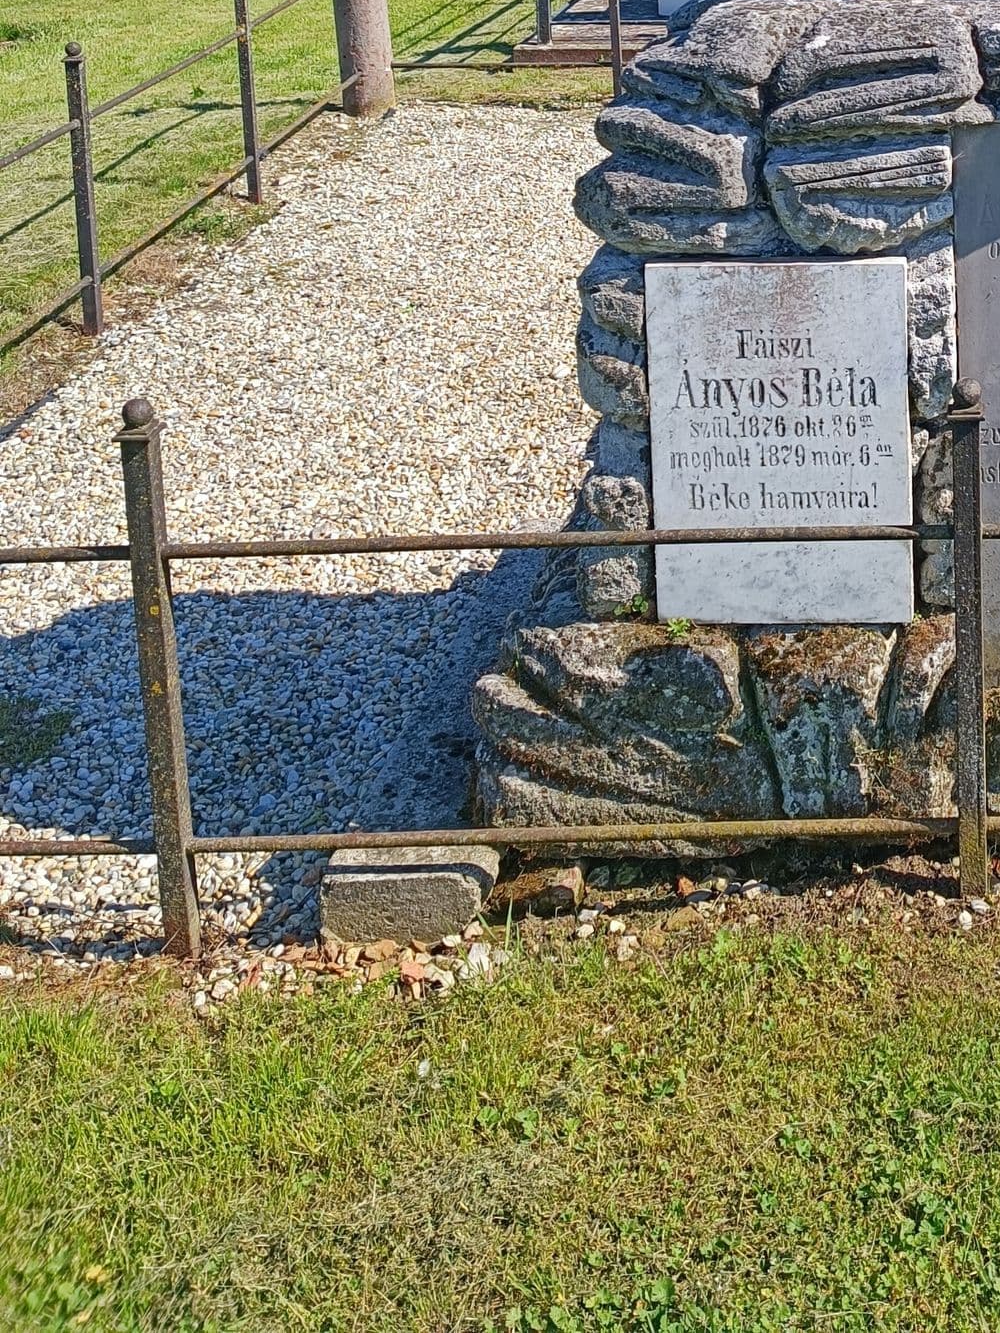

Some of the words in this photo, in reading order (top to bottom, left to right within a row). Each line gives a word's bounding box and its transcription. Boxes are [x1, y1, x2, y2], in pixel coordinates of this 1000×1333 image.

[671, 359, 789, 416] Ányos
[800, 367, 881, 409] Béla
[669, 445, 751, 473] meghalt
